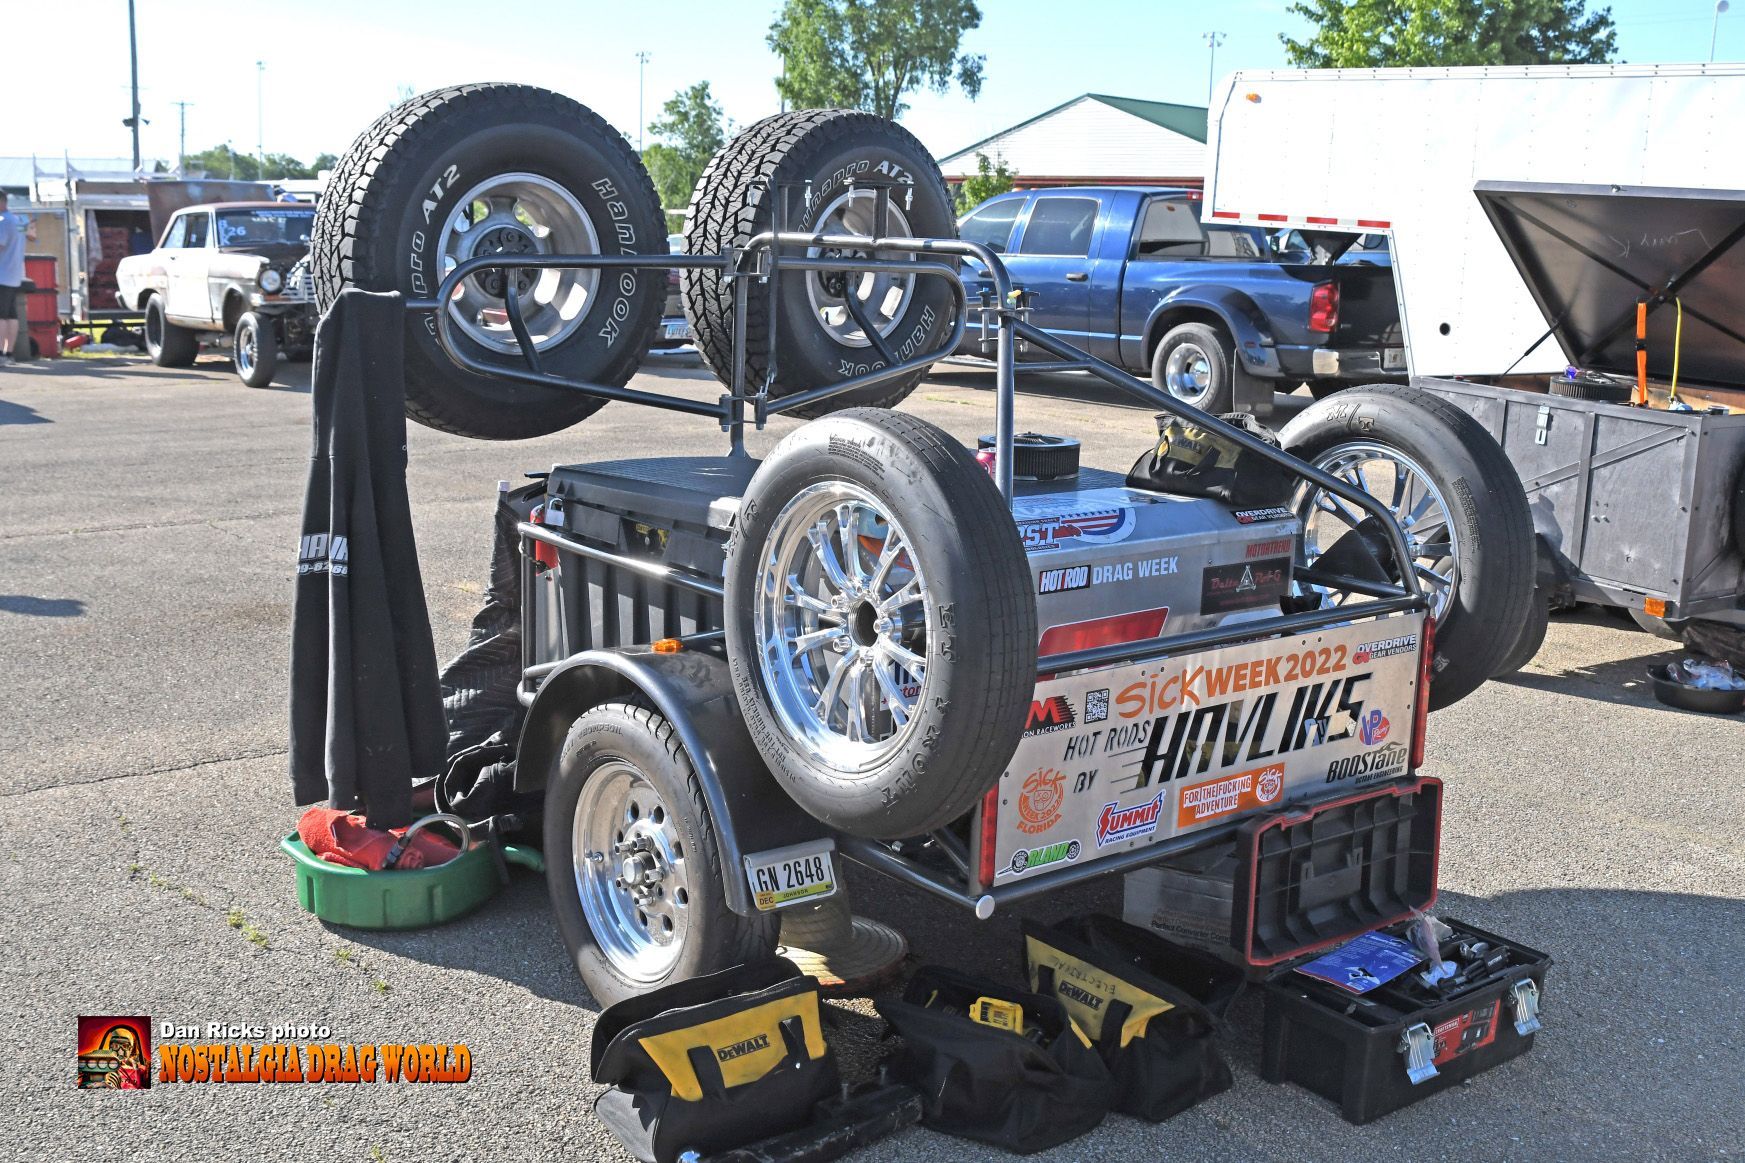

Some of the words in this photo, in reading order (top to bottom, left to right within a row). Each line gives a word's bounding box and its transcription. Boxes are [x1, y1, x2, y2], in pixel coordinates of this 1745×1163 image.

[873, 160, 913, 183] AT2
[421, 164, 461, 224] AT2
[592, 177, 636, 348] Hanook
[838, 305, 936, 377] Hanook
[1235, 507, 1288, 518] OVERDRIVE
[1245, 538, 1291, 558] MOTORTREND
[1040, 570, 1064, 593] HOT
[1064, 566, 1088, 589] ROD
[1093, 562, 1132, 585] DRAG
[1138, 556, 1178, 578] WEEK
[1357, 634, 1416, 652] OVERDRIVE
[1370, 649, 1386, 659] GEAR
[1387, 644, 1417, 657] VENDORS
[1205, 655, 1283, 698] WEEK
[1283, 644, 1348, 683] 2022
[1036, 722, 1076, 736] RACEWORKS
[1361, 709, 1382, 745] VP
[1063, 731, 1102, 761] HOT
[1104, 720, 1151, 752] RODS
[1073, 769, 1098, 793] BY
[1373, 765, 1403, 781] ENGINEERING
[1184, 788, 1200, 806] FOR
[1202, 783, 1217, 799] THE
[1217, 774, 1252, 795] FUCKING
[1195, 794, 1238, 816] ADVENTURE
[1017, 813, 1062, 835] FLORIDA
[1104, 834, 1125, 844] RACING
[1126, 826, 1156, 839] EQUIPMENT
[756, 866, 780, 892] GN
[783, 856, 825, 889] 2648
[759, 896, 774, 906] DEC
[783, 889, 808, 899] JOHNSON
